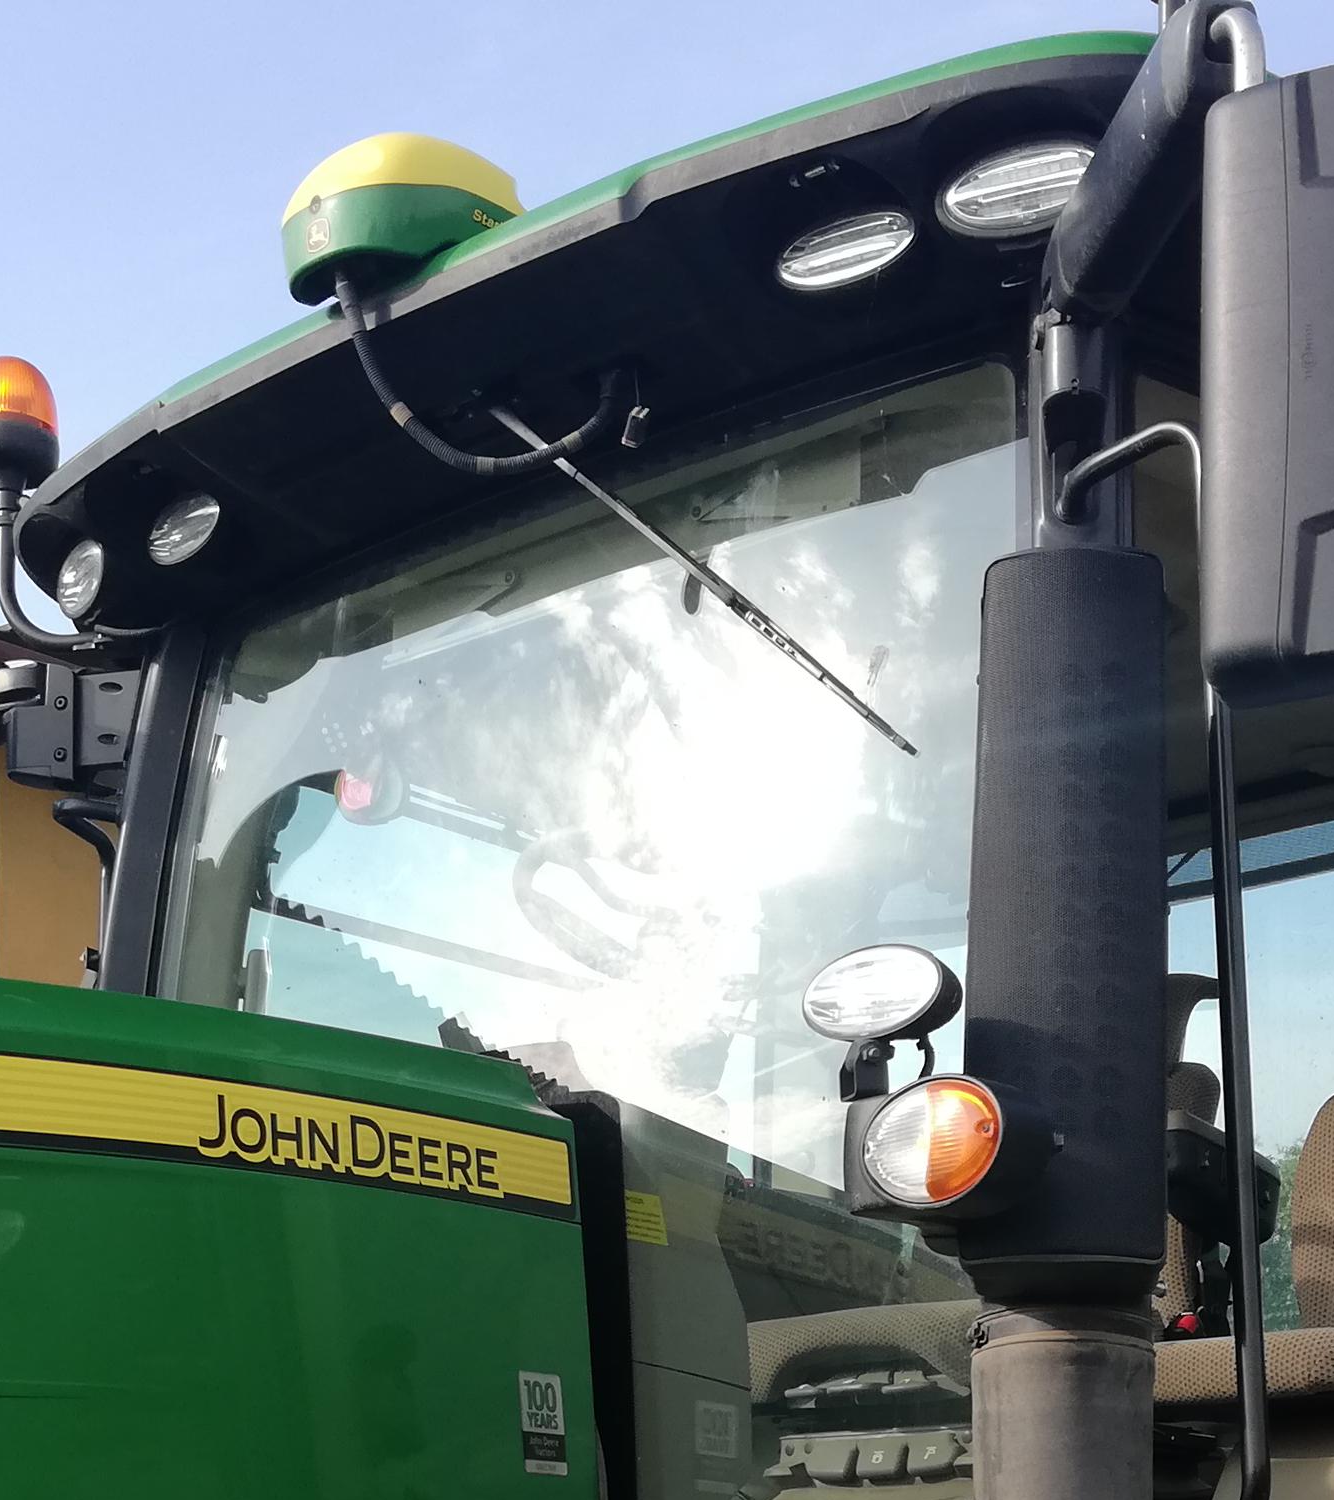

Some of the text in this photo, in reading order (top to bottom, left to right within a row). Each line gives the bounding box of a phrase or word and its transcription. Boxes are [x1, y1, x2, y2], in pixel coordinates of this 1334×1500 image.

[198, 1093, 502, 1193] JOHN DEERE
[524, 1379, 557, 1413] 100
[527, 1411, 559, 1430] YEARS
